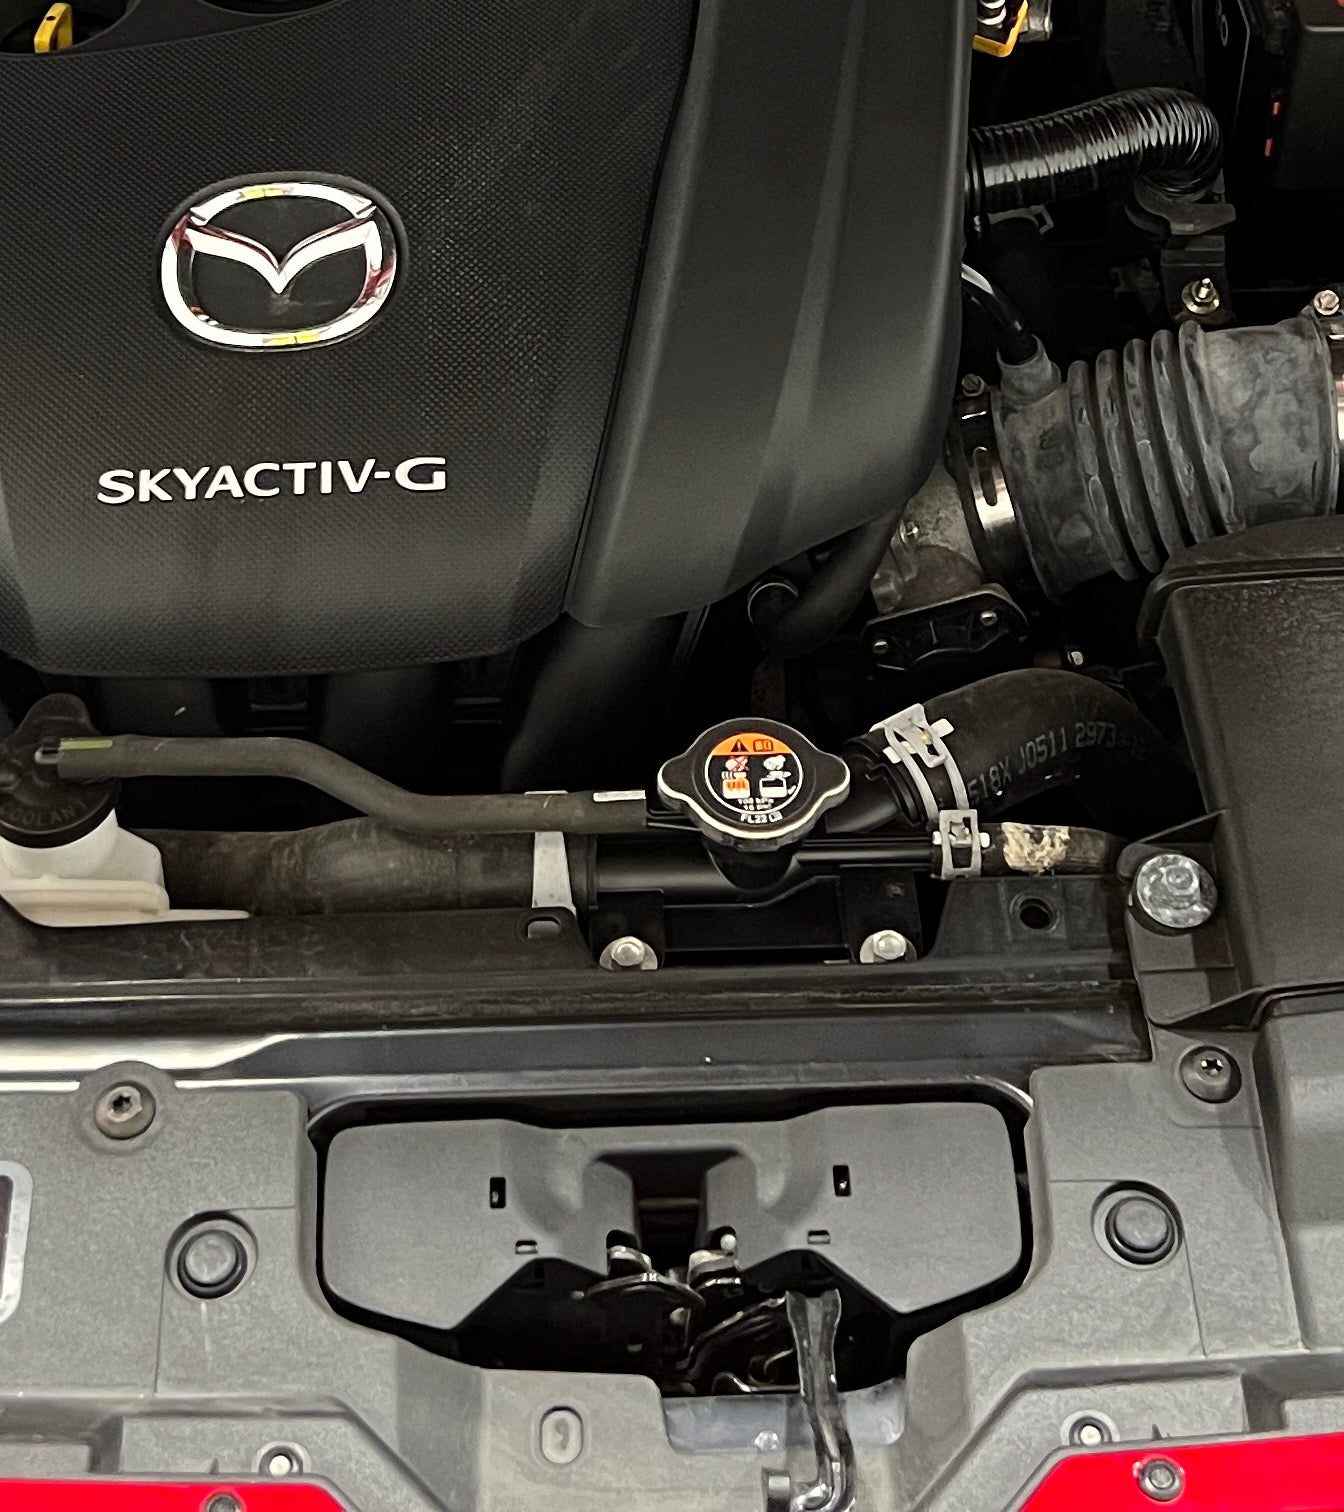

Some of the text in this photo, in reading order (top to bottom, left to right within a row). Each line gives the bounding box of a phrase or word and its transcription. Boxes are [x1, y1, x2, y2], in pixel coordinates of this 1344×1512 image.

[96, 455, 448, 504] SKYACTIV-G
[1075, 721, 1117, 748] 2973
[740, 813, 768, 824] FL22
